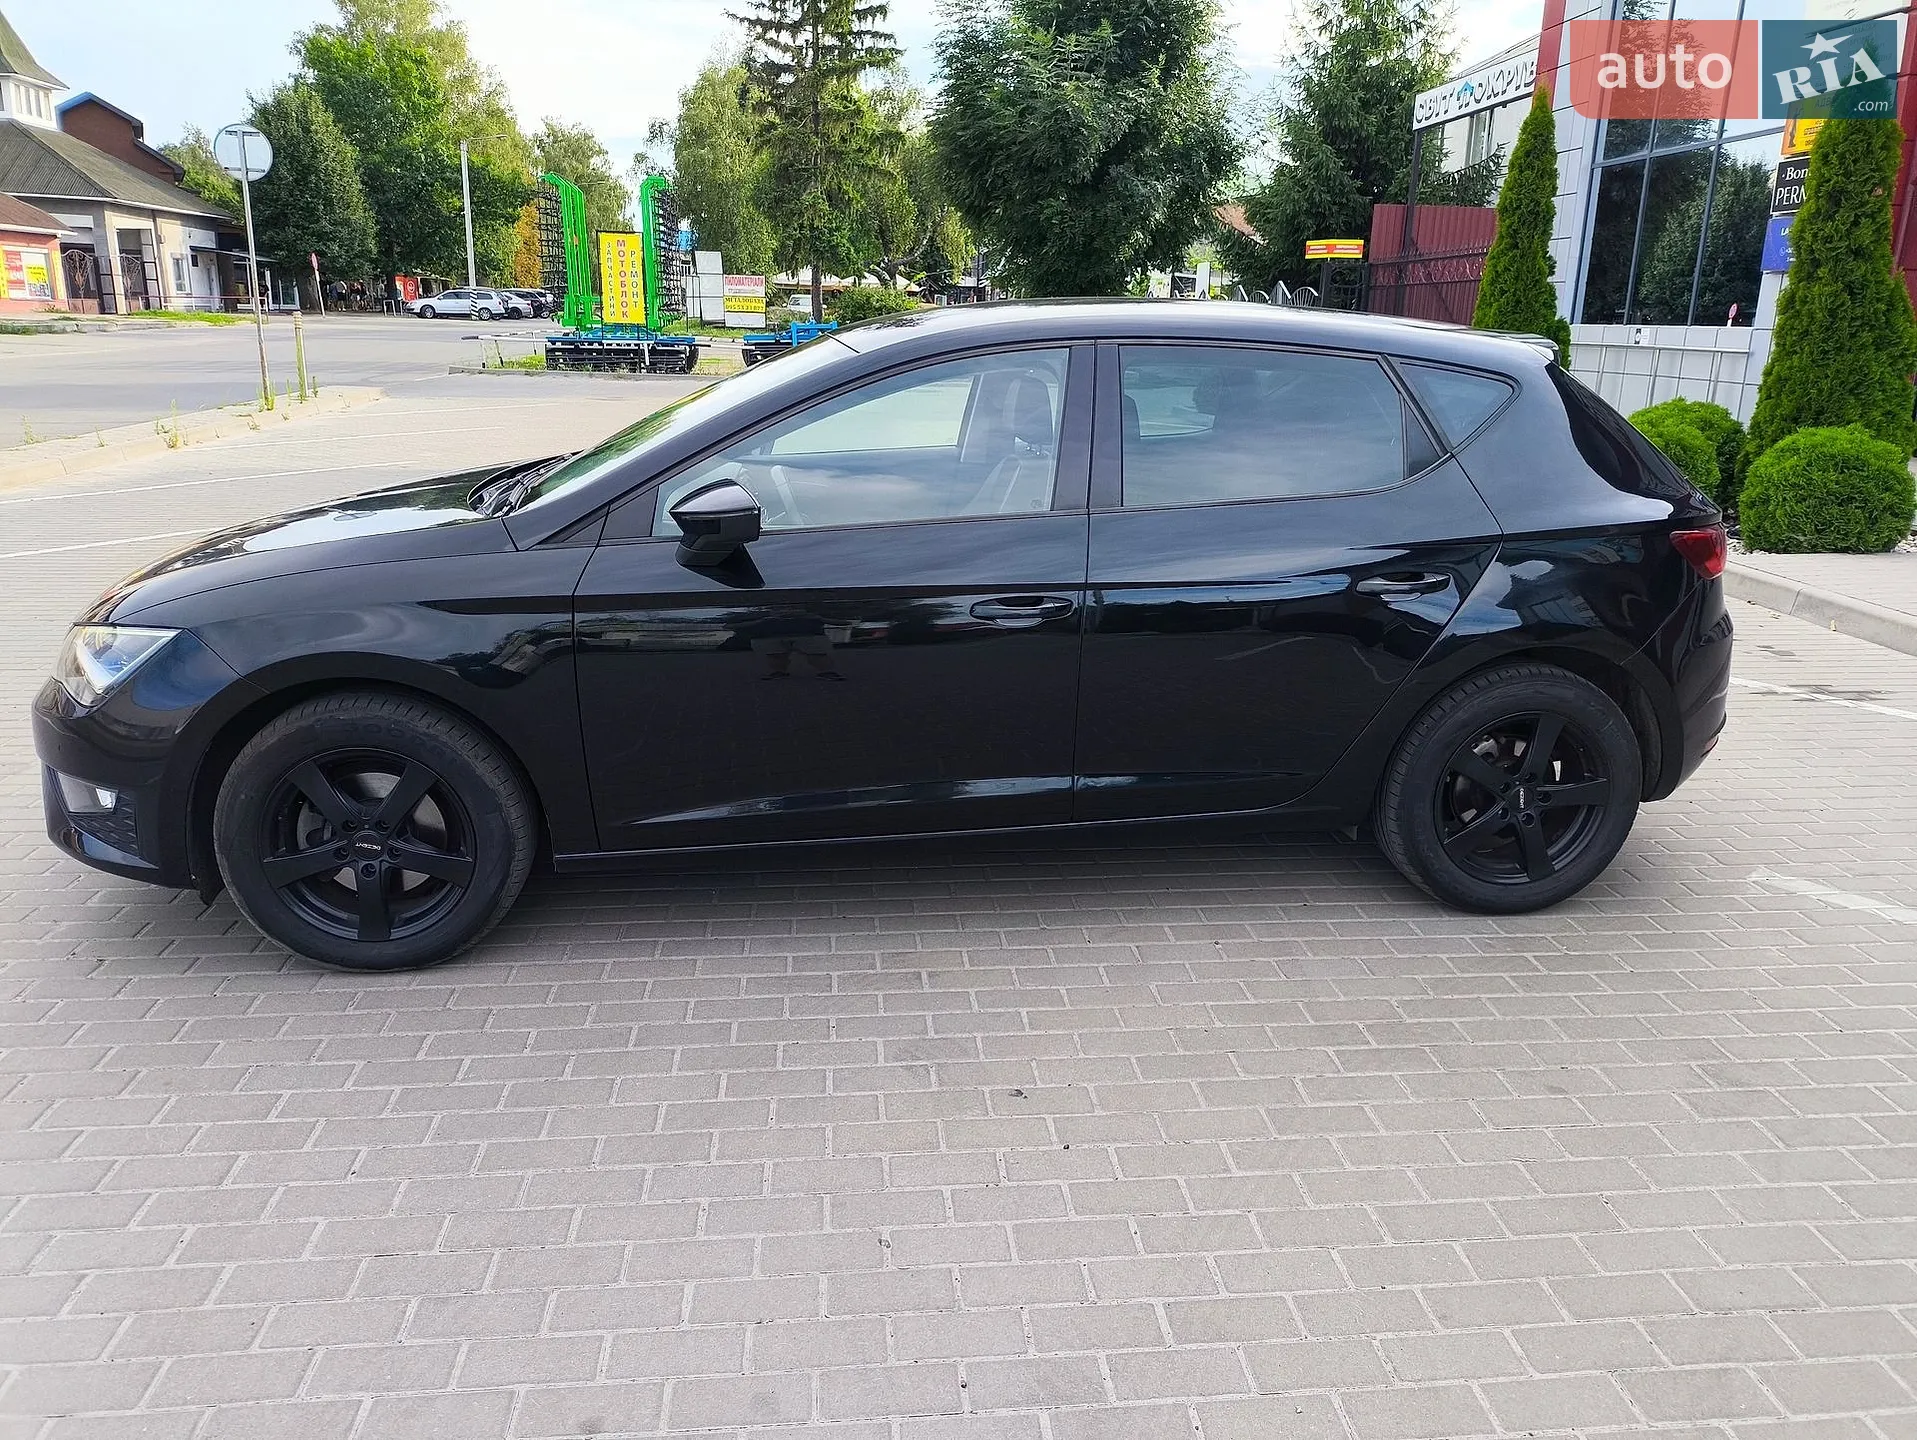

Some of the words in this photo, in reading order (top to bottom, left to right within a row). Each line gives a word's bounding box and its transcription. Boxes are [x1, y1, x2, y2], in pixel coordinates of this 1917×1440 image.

[1415, 87, 1455, 124] СВІТ
[606, 242, 616, 317] ЗАПЧАСТИНИ
[616, 239, 629, 319] МОТОБЛОК
[630, 250, 639, 309] РЕМОНТ
